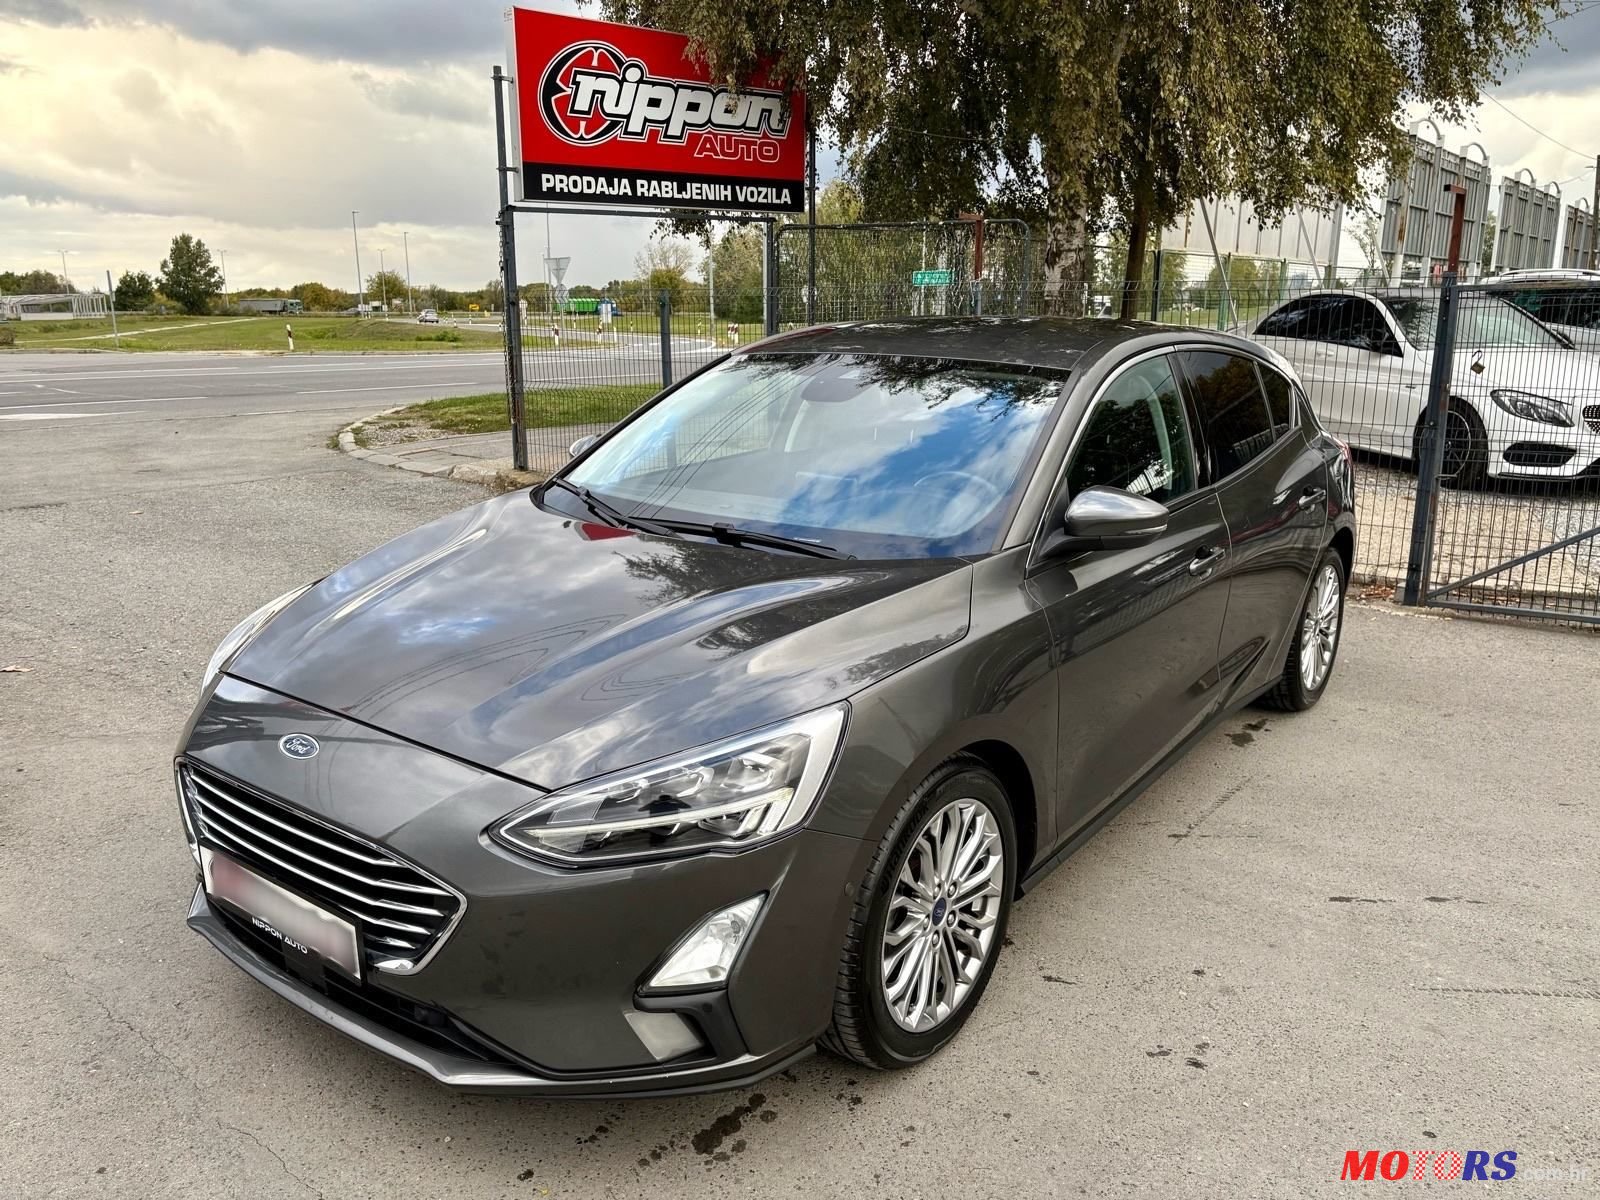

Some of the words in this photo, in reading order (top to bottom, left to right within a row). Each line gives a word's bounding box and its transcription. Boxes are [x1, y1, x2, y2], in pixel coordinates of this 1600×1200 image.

[567, 62, 790, 143] nippon
[694, 133, 780, 162] AUTO
[541, 174, 632, 196] PRODAJA
[637, 179, 731, 201] RABLJENIH
[735, 186, 792, 204] VOZILA
[285, 737, 313, 755] Ford
[252, 916, 282, 940] NIPPON
[284, 935, 308, 954] AUTO
